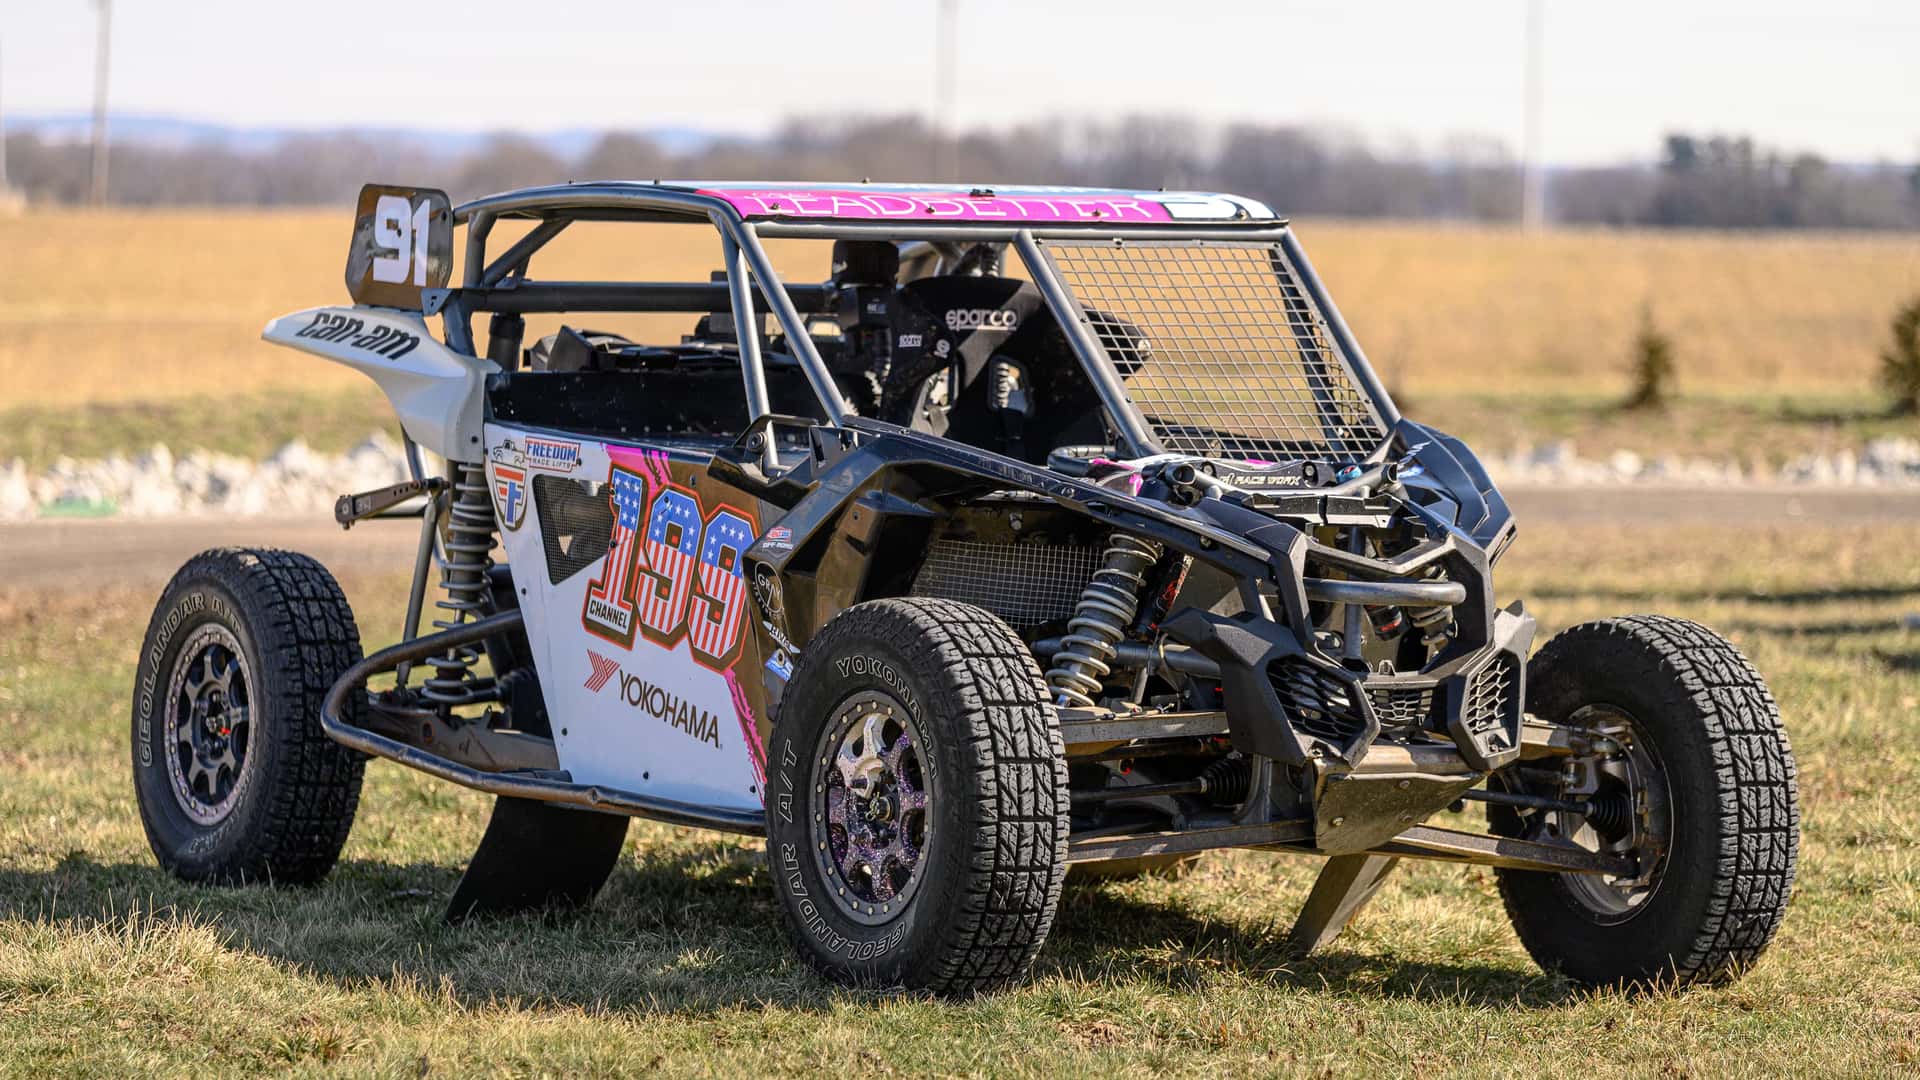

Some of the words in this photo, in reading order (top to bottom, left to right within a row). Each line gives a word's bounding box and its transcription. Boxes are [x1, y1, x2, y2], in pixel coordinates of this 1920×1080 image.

[372, 195, 430, 287] 91
[945, 309, 1017, 332] sparco
[525, 439, 577, 462] FREEDOM
[588, 465, 754, 660] 199
[588, 599, 628, 630] CHANNEL
[138, 592, 205, 768] GEOLANDAR
[618, 668, 720, 750] YOKOHAMA
[835, 654, 939, 780] YOKOHAMA
[777, 738, 798, 824] A/T
[780, 842, 907, 961] GEOLANDAR
